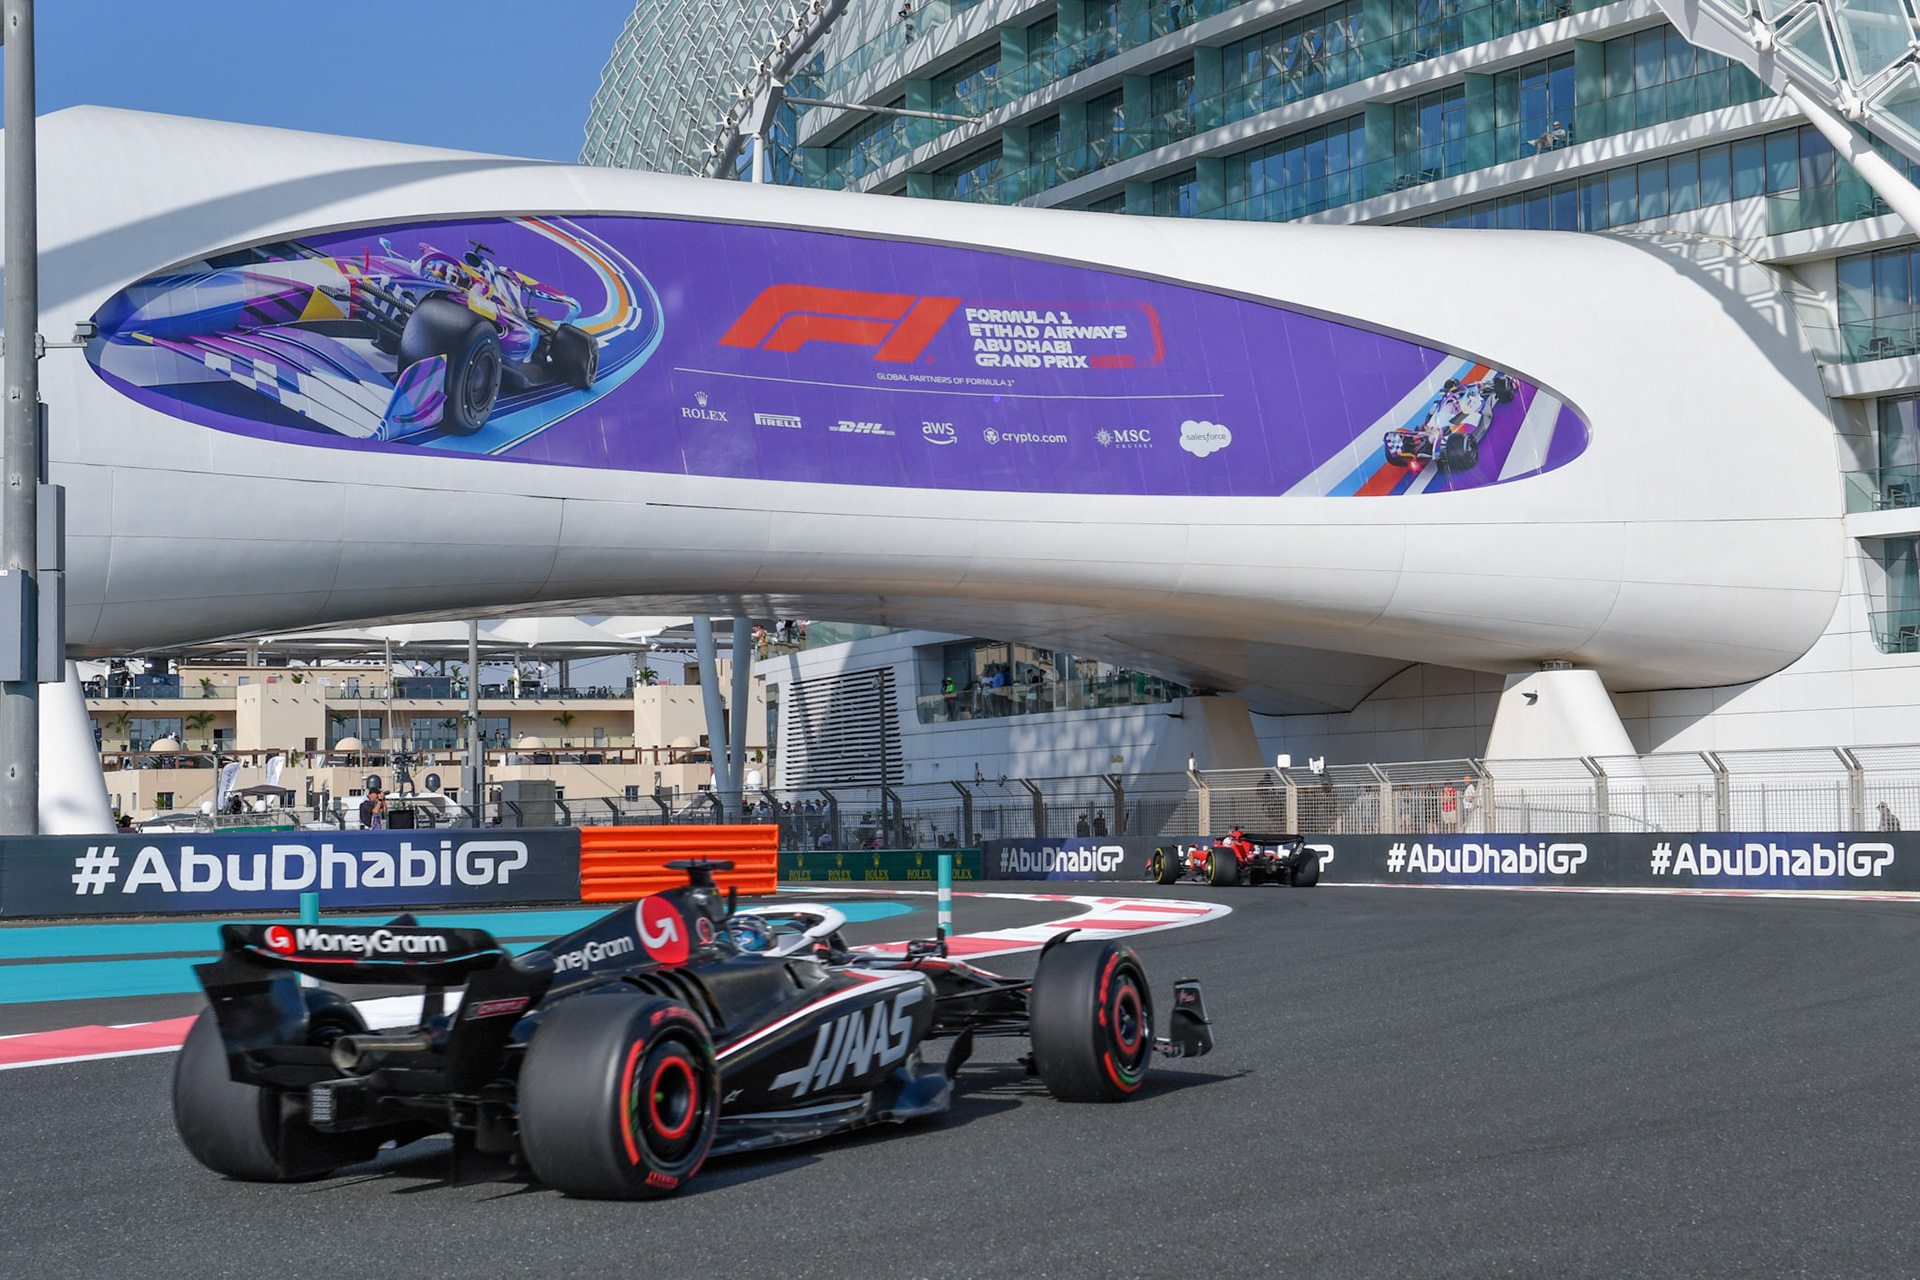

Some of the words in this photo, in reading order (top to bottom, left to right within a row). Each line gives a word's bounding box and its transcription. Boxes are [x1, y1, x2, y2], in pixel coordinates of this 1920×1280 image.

[718, 284, 963, 363] F1
[965, 308, 1058, 324] FORMULA
[1060, 311, 1072, 324] 1
[968, 323, 1039, 338] ETIHAD
[1043, 325, 1128, 339] AIRWAYS
[973, 338, 1012, 352] ABU
[1014, 340, 1072, 353] DHABI
[975, 353, 1041, 368] GRAND
[1043, 355, 1089, 368] PRIX
[877, 372, 909, 382] GLOBAL
[909, 374, 952, 384] PARTNERS
[953, 377, 964, 385] OF
[966, 378, 1006, 386] FORMULA
[681, 407, 728, 422] ROLEX
[754, 412, 802, 428] PIRELLI
[837, 420, 887, 435] DHL
[922, 421, 955, 435] aws
[1002, 432, 1067, 443] crypto.com
[1113, 429, 1151, 442] MSC
[1186, 432, 1226, 442] salesforce
[1000, 845, 1124, 873] #AbuDhabiGP
[1388, 843, 1588, 874] #AbuDhabiGP
[1651, 843, 1895, 877] #AbuDhabiGP
[72, 841, 528, 895] #AbuDhabiGP
[789, 870, 812, 881] ROLEX
[828, 870, 851, 881] ROLEX
[865, 870, 889, 881] ROLEX
[907, 869, 931, 880] ROLEX
[952, 869, 973, 880] OLEX
[296, 928, 448, 957] MoneyGram
[553, 936, 635, 973] oneyGram
[768, 986, 924, 1098] HAAS
